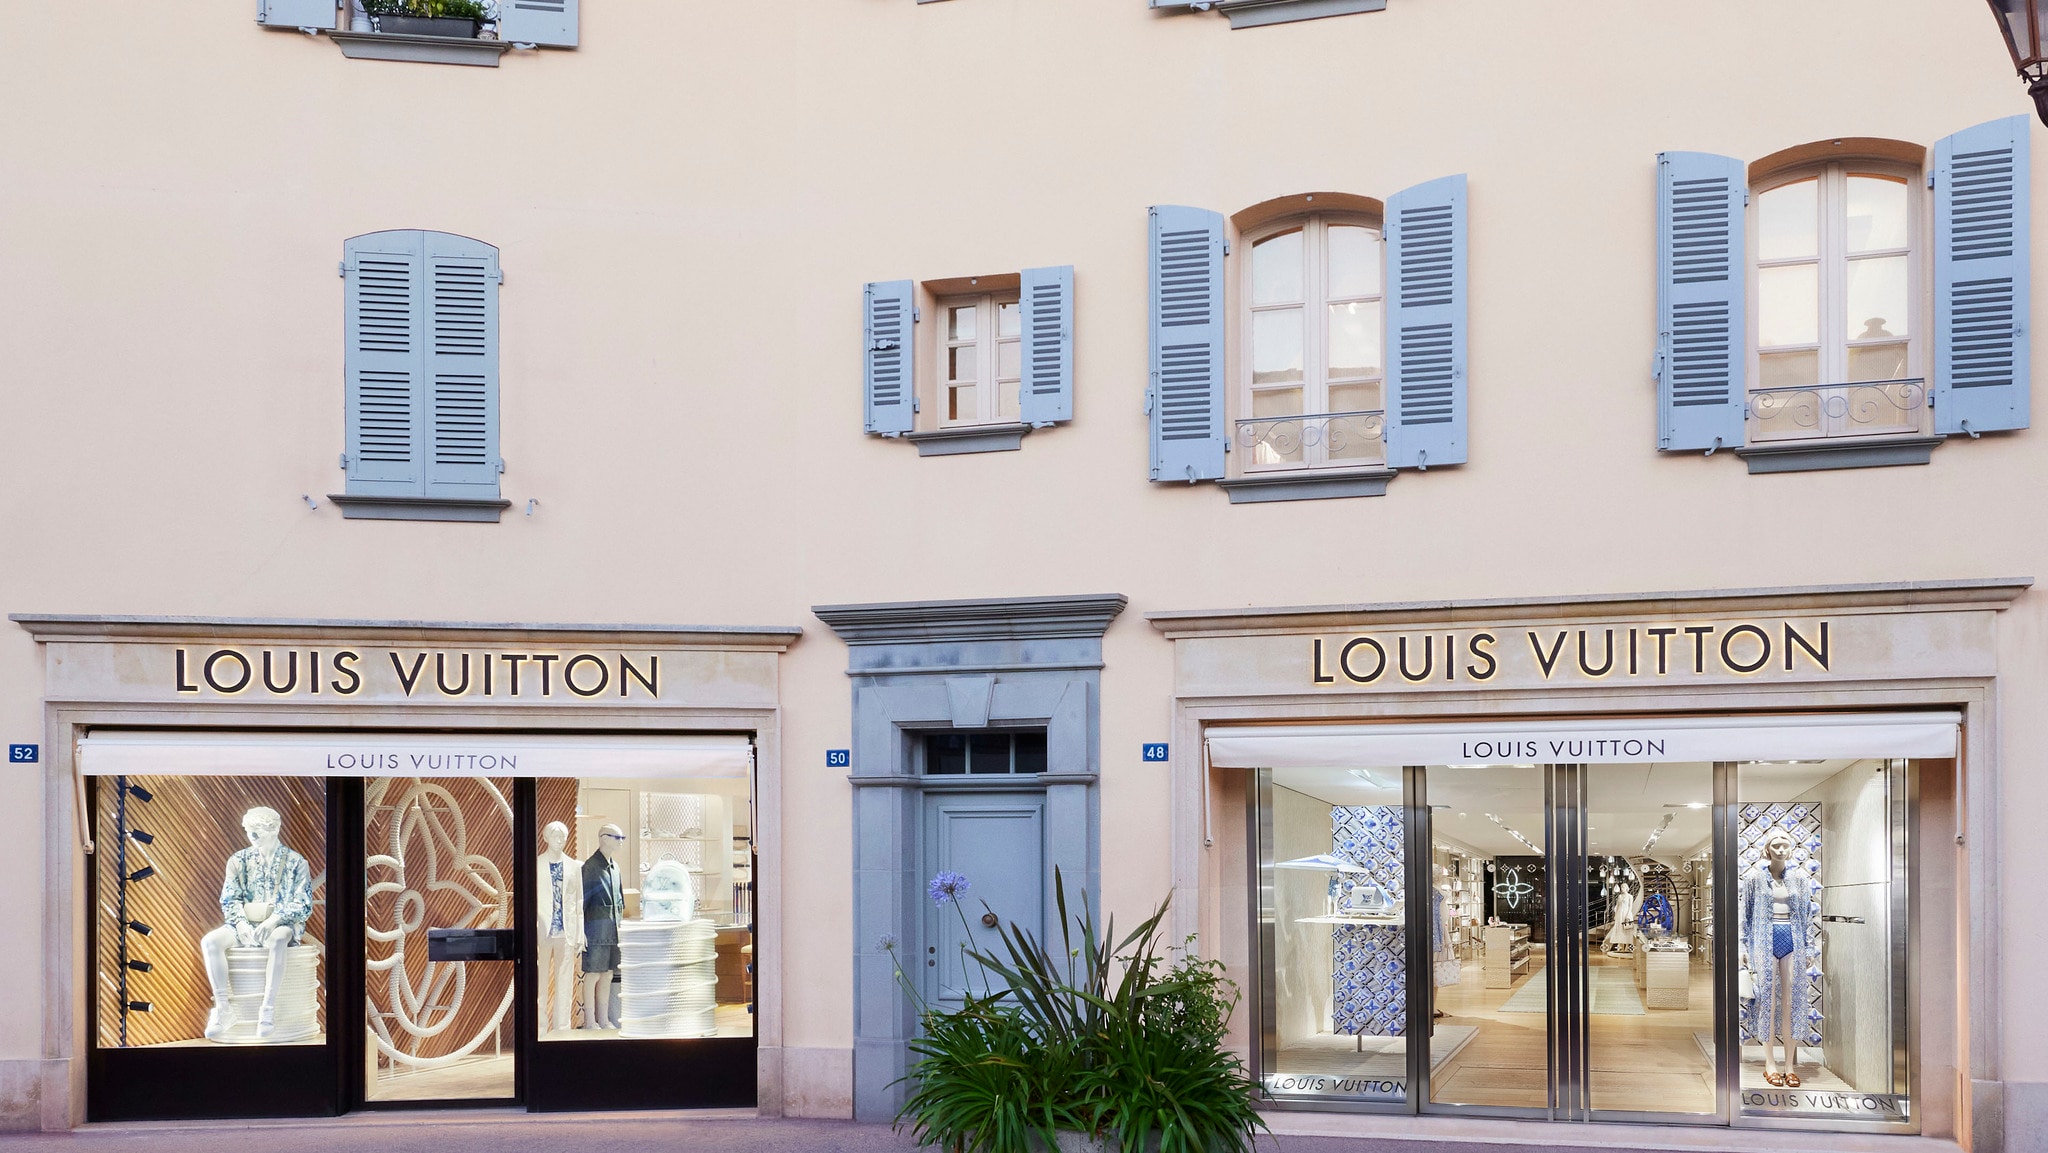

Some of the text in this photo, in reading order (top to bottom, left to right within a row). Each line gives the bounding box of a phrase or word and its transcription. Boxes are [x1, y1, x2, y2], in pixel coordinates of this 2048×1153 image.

[1314, 621, 1829, 683] LOUIS VUITTON
[176, 648, 658, 698] LOUIS VUITTON
[14, 747, 33, 760] 52
[1146, 746, 1165, 759] 48
[1463, 739, 1665, 759] LOUIS VUITTON
[327, 753, 517, 770] LOUIS VUITTON
[830, 752, 846, 765] 50
[1273, 1078, 1408, 1093] LOUIS VUITTON
[1741, 1092, 1897, 1111] LOUIS VUITTON
